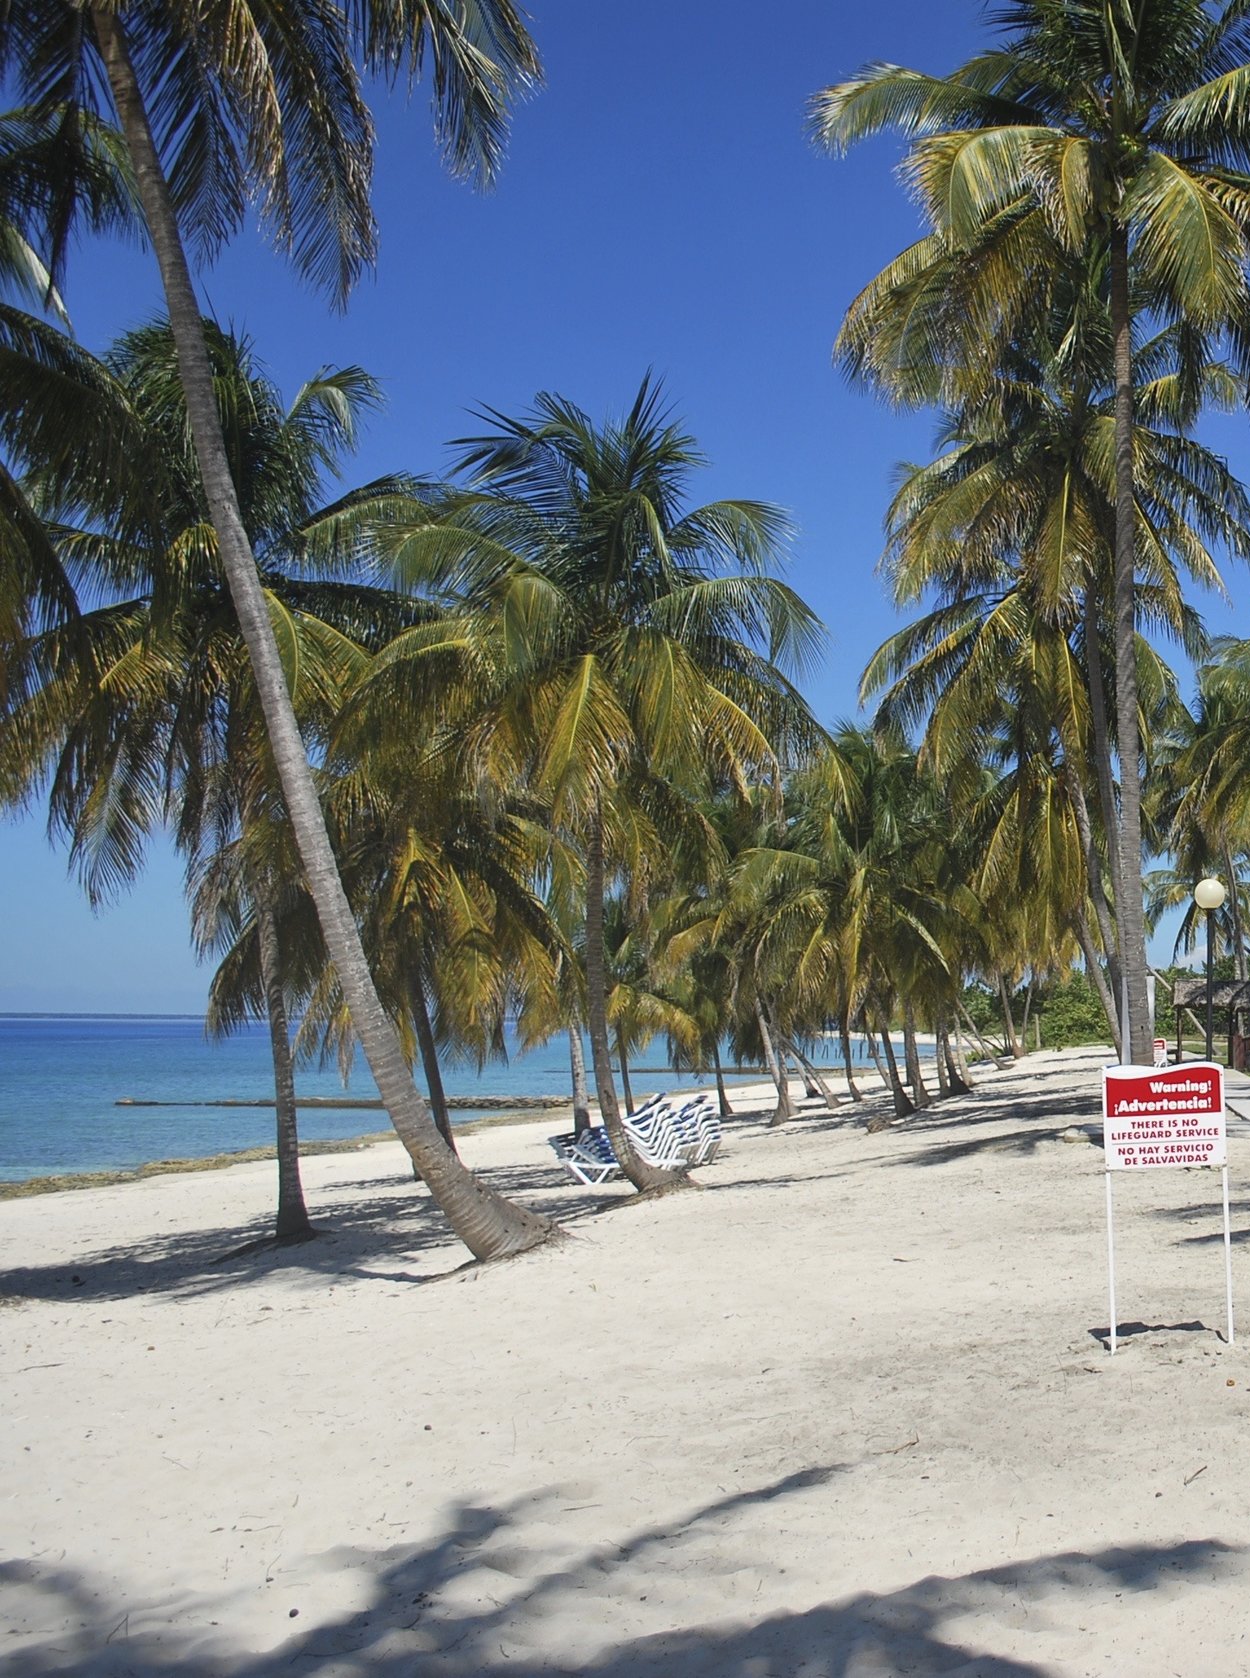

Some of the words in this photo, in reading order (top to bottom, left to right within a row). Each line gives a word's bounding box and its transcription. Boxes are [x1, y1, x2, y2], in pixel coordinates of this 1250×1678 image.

[1149, 1080, 1212, 1093] Warning!
[1114, 1096, 1212, 1115] ¡Advertencia!
[1131, 1120, 1164, 1129] THERE
[1182, 1119, 1198, 1127] NO
[1111, 1130, 1172, 1140] LIFEGUARD
[1176, 1128, 1219, 1137] SERVICE
[1118, 1147, 1135, 1155] NO
[1139, 1146, 1160, 1155] HAY
[1164, 1143, 1214, 1153] SERVICIO
[1124, 1157, 1138, 1166] DE
[1142, 1154, 1208, 1165] SALVAVIDAS
